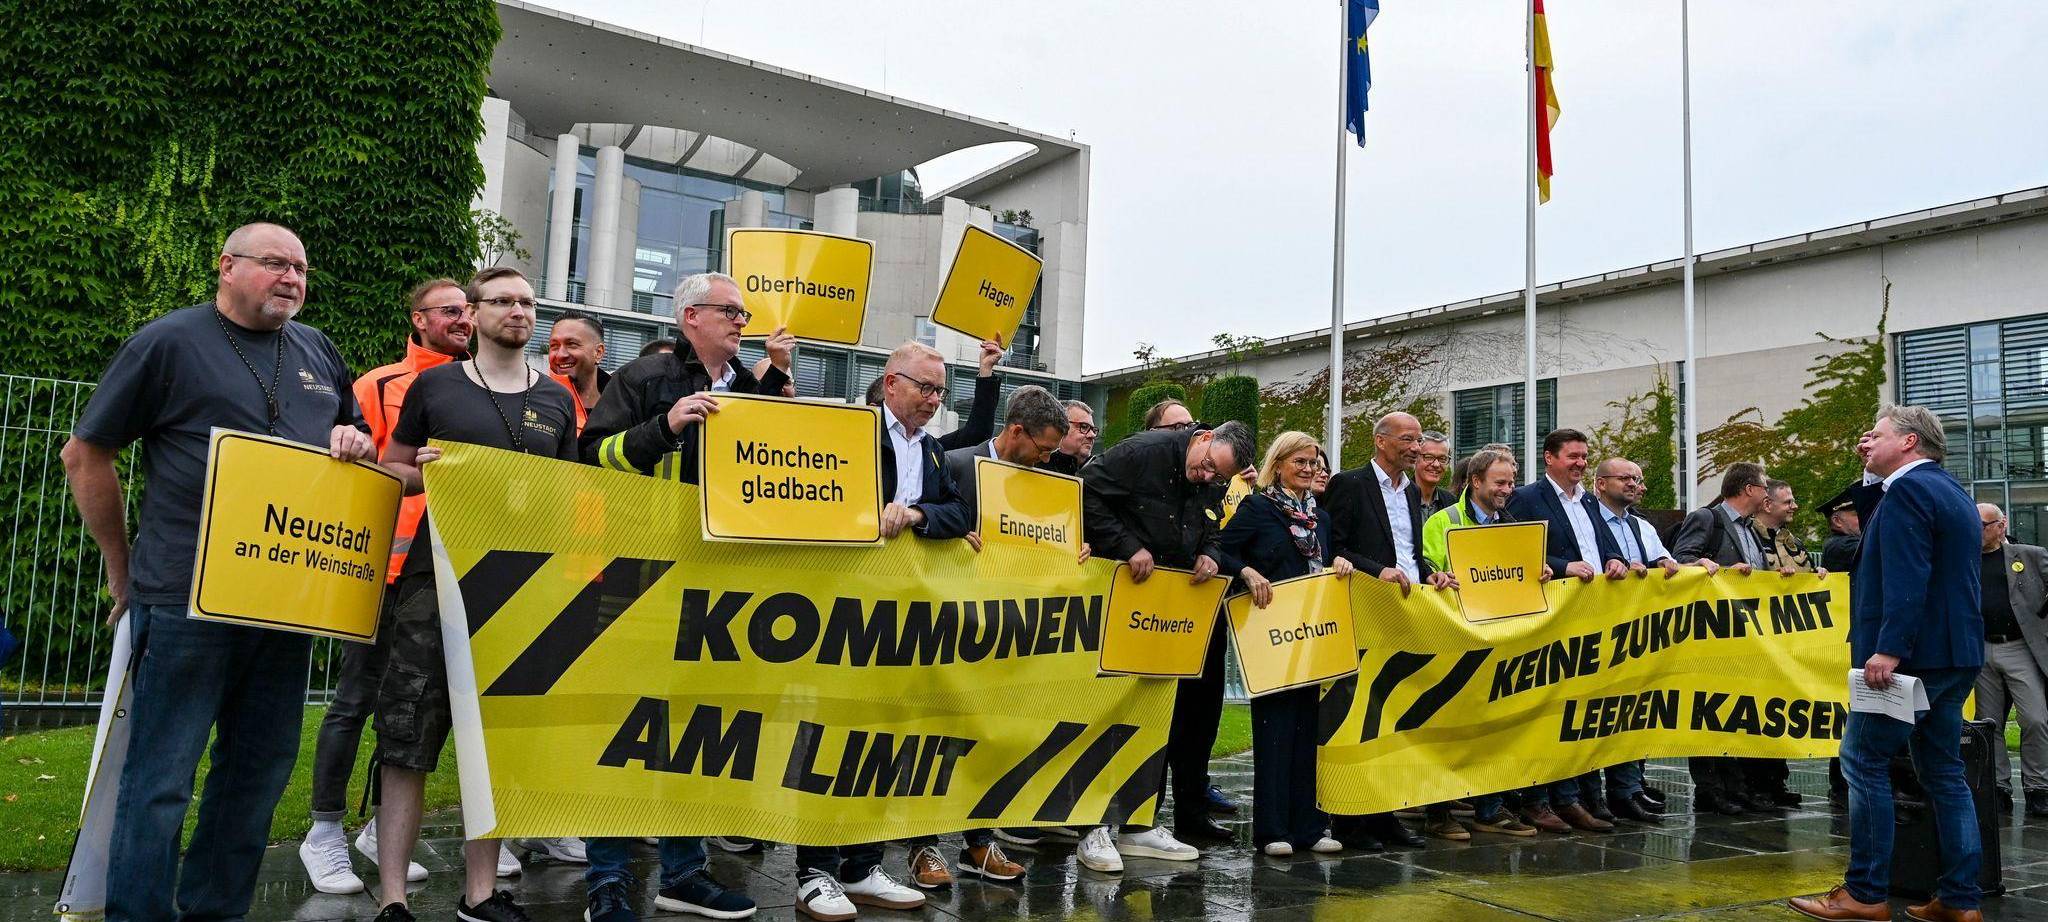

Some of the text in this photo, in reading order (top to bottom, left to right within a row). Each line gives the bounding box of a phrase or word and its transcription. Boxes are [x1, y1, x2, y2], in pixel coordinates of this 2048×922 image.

[746, 275, 855, 302] Oberhausen
[978, 279, 1015, 308] Hagen
[524, 421, 556, 433] NEUSTADT
[736, 440, 848, 470] Mönchen-
[742, 475, 843, 503] gladbach
[264, 503, 371, 554] Neustadt
[1000, 513, 1067, 544] Ennepetal
[235, 541, 375, 581] an der Weinstraße
[1470, 565, 1523, 582] Duisburg
[674, 589, 1103, 666] KOMMUNEN
[1128, 611, 1194, 633] Schwerte
[1268, 620, 1338, 646] Bochum
[1488, 590, 1834, 703] KEINE ZUKUNFT MIT
[1559, 690, 1680, 742] LEEREN
[597, 697, 977, 797] AM LIMIT
